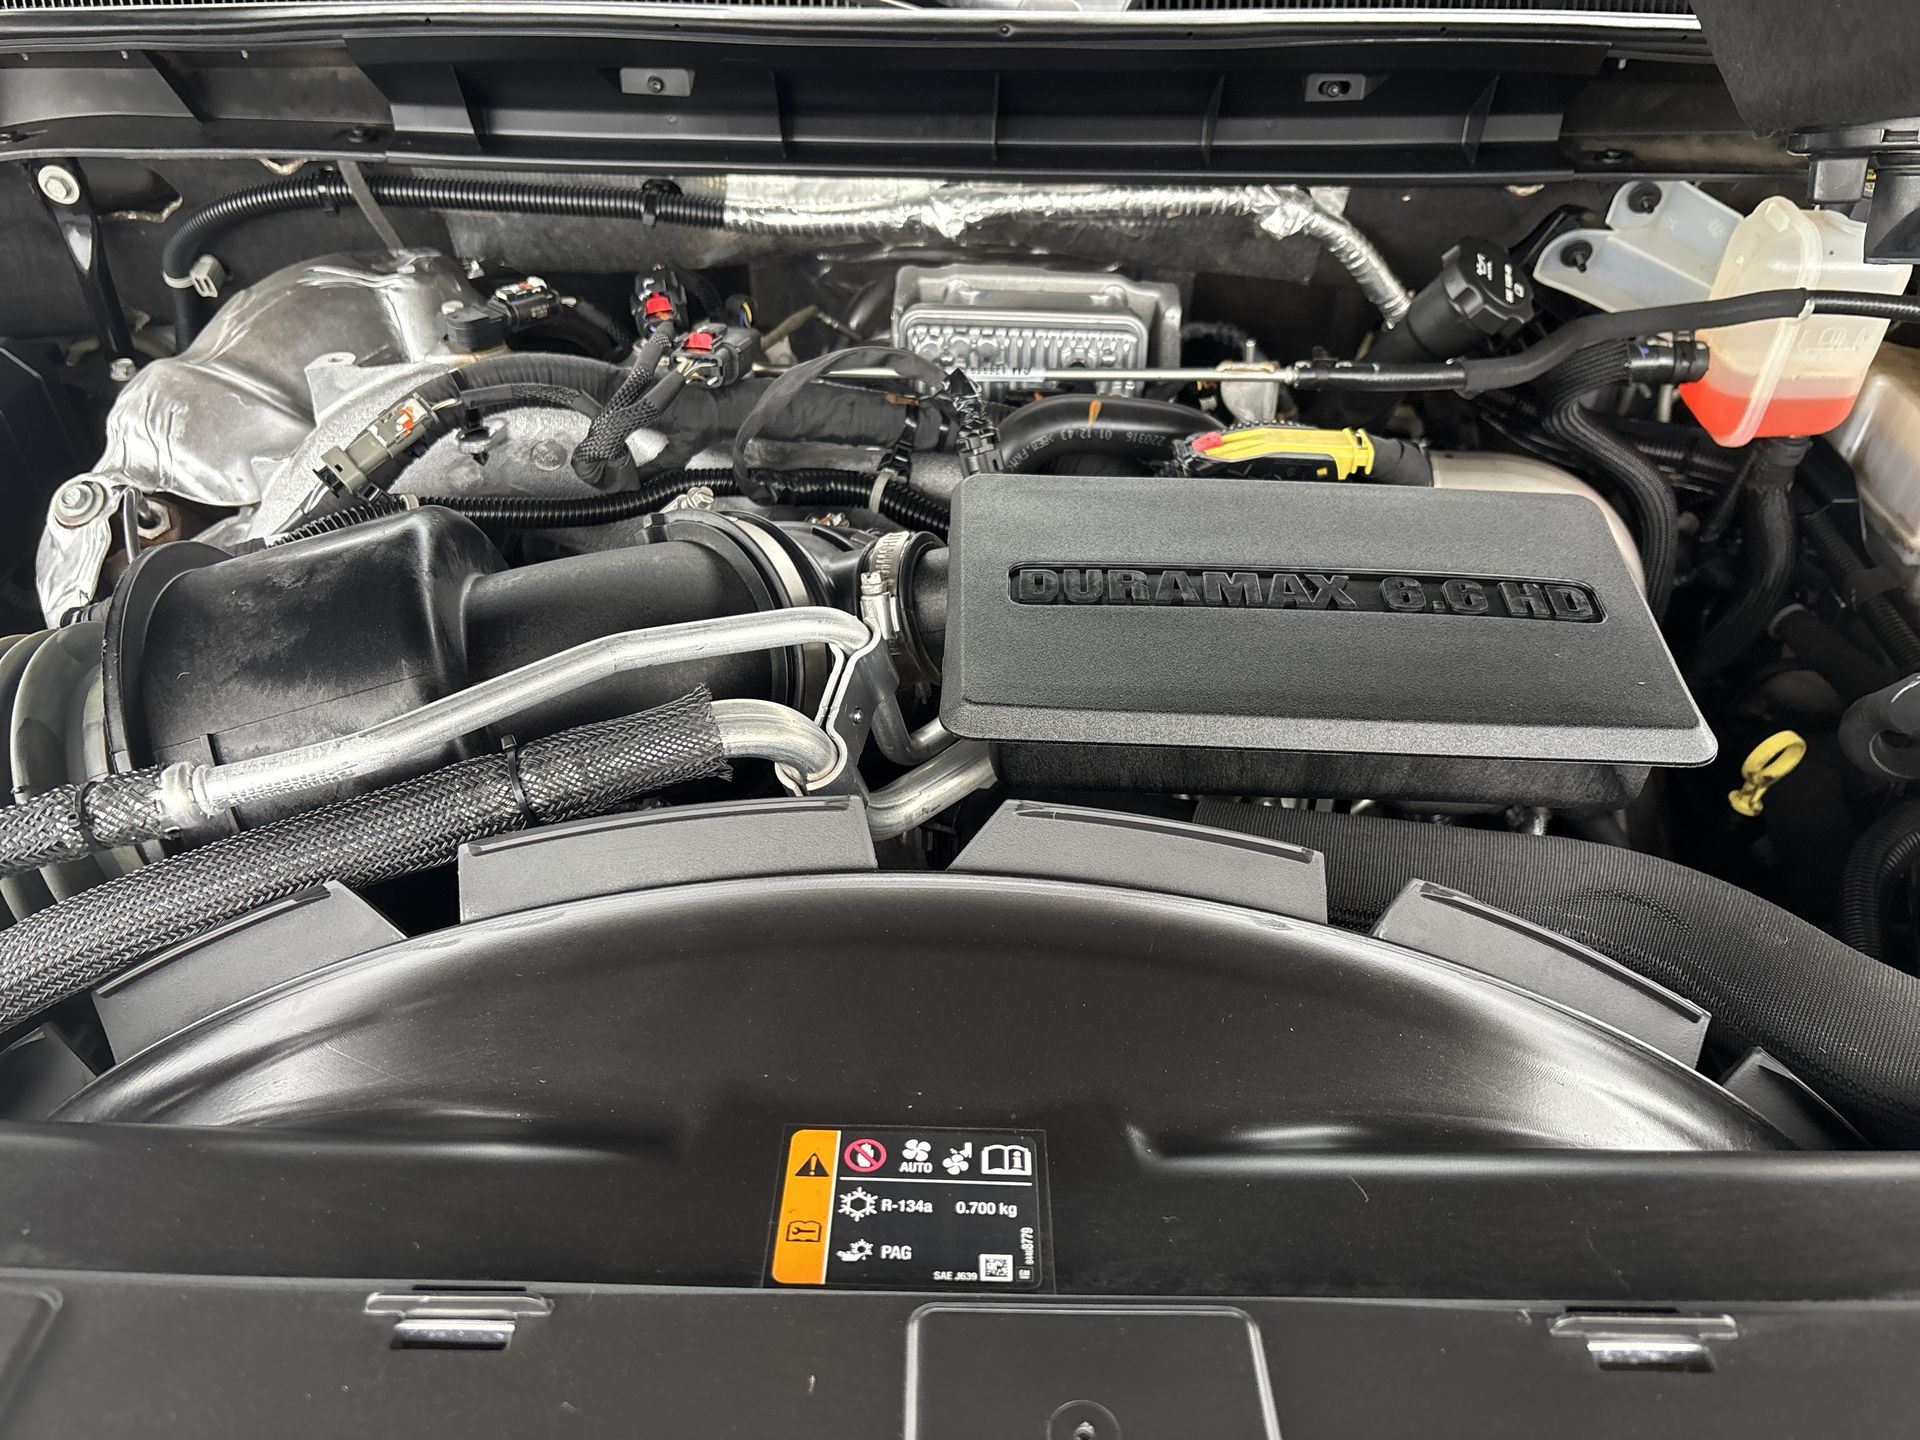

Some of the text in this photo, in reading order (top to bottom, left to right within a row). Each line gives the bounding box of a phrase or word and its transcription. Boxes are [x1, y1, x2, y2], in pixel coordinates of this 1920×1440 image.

[1019, 569, 1595, 620] DURAMAX 6.6 HD
[898, 1160, 934, 1174] AUTO
[880, 1198, 1018, 1219] R-134a 0.700 kg
[880, 1245, 913, 1261] PAG
[932, 1270, 978, 1281] SAE J639
